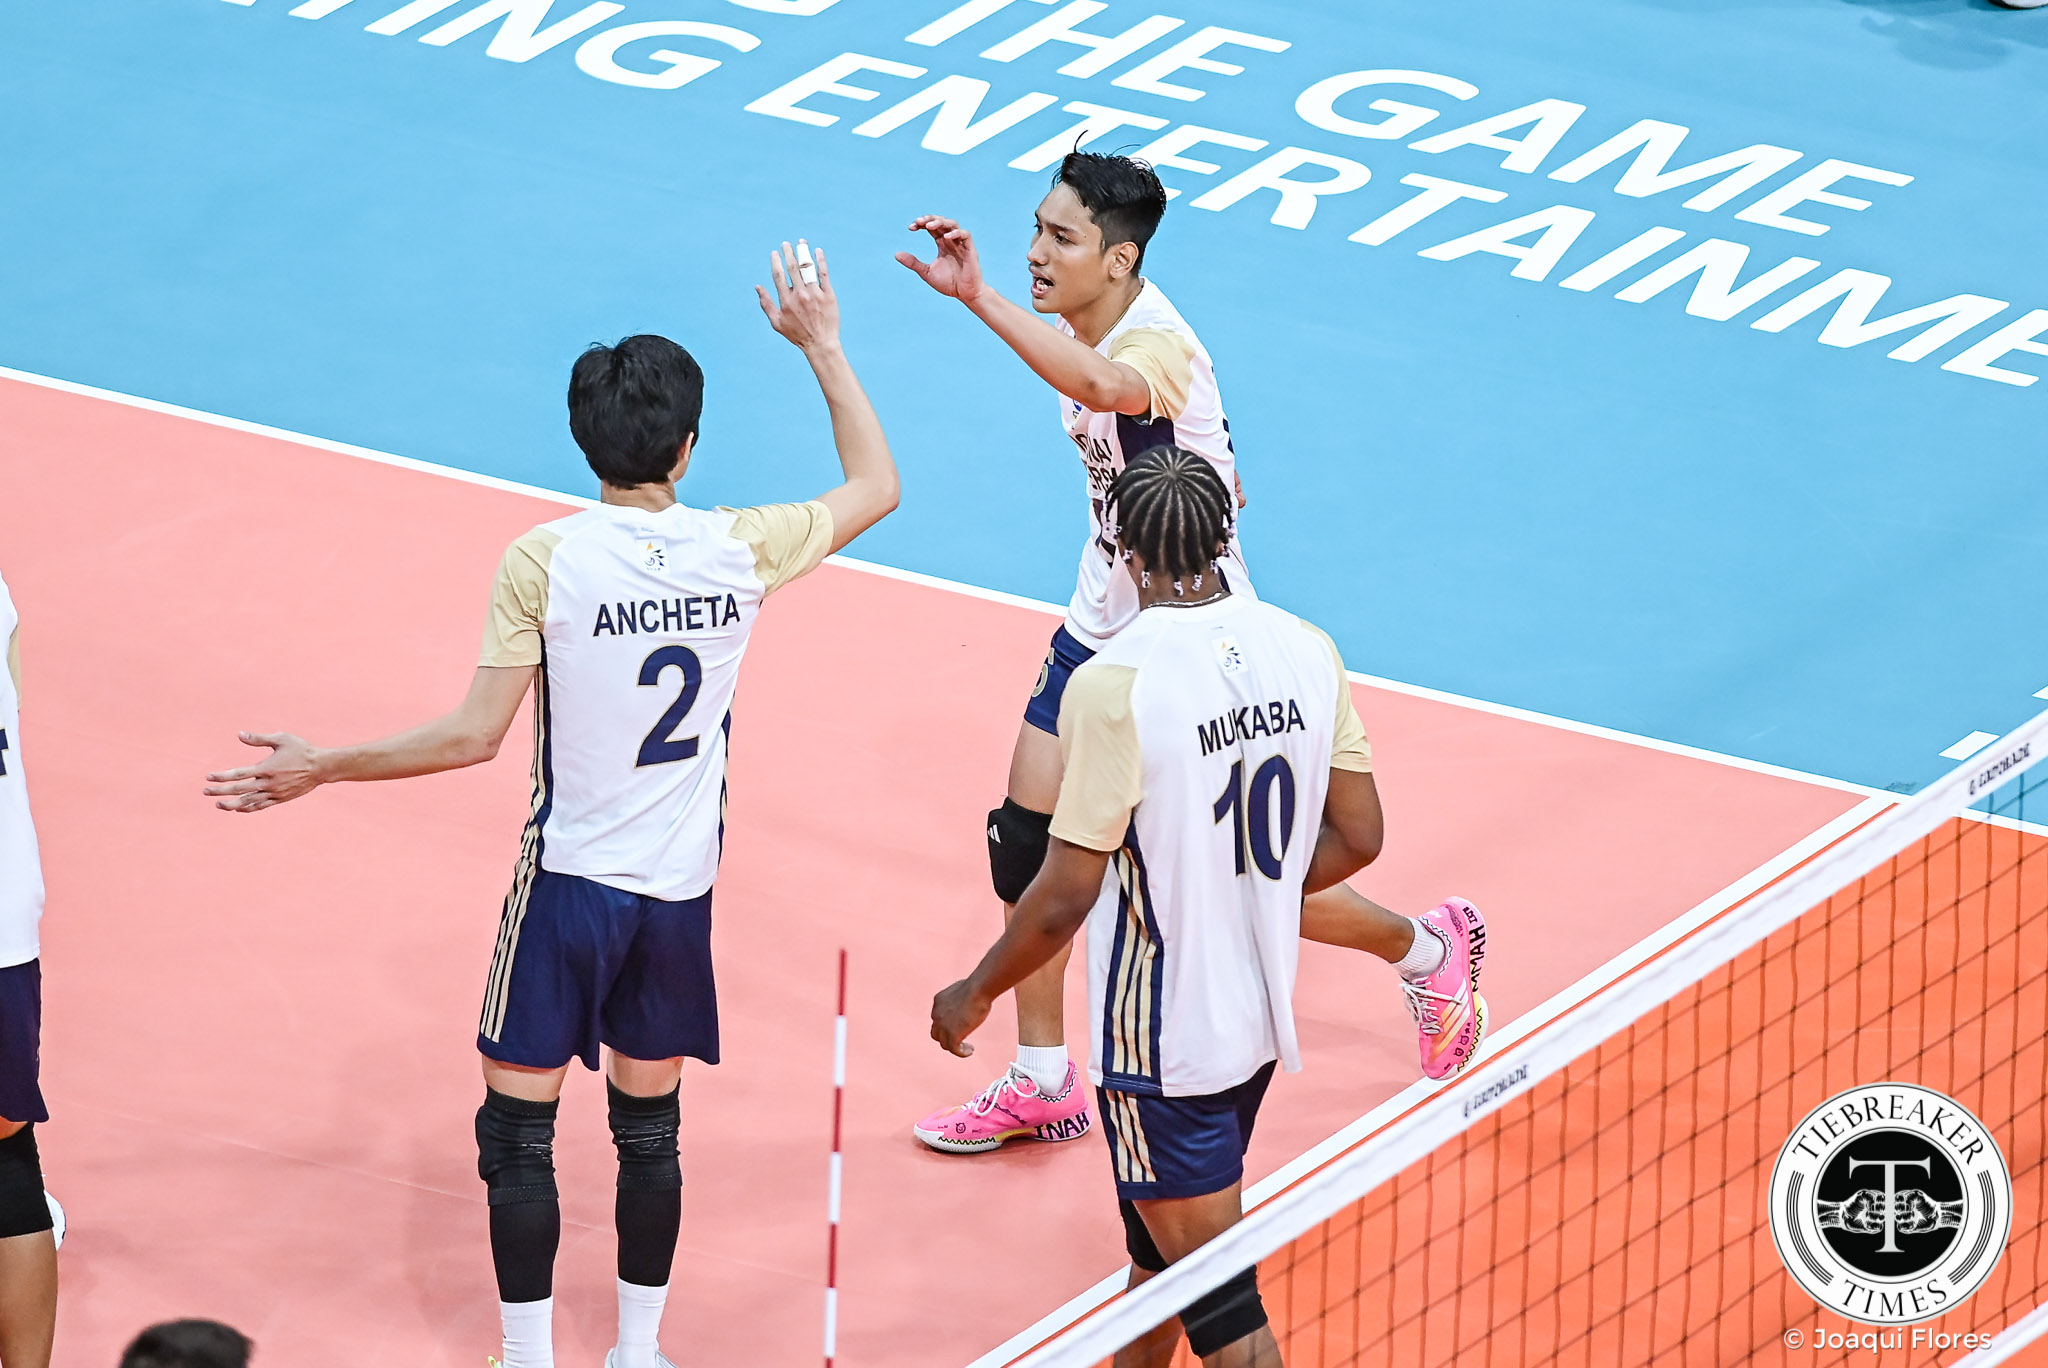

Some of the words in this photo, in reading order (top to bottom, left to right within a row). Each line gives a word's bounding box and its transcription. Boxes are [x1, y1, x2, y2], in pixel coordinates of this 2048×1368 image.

[905, 0, 1291, 102] THE
[1295, 69, 1915, 236] GAME
[592, 593, 741, 637] ANCHETA
[634, 643, 703, 770] 2
[1197, 698, 1306, 757] MUKABA
[1212, 752, 1296, 881] 10
